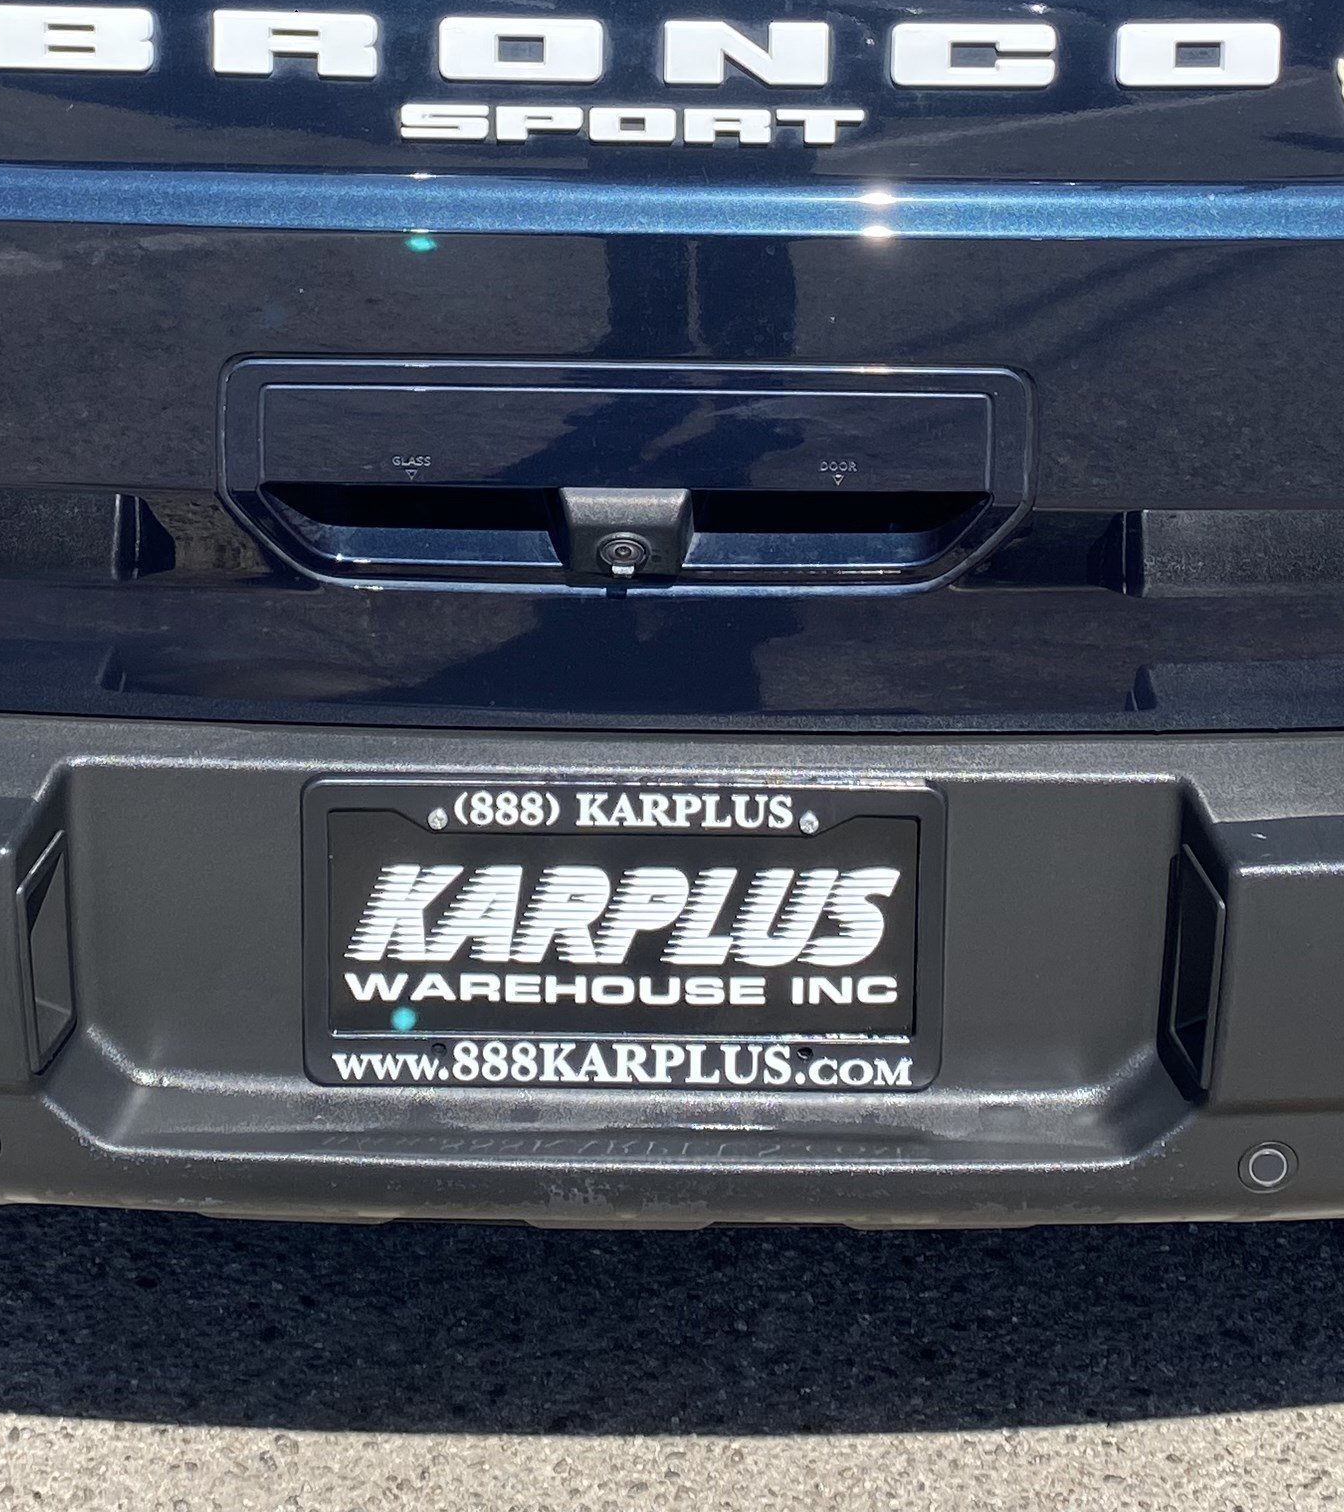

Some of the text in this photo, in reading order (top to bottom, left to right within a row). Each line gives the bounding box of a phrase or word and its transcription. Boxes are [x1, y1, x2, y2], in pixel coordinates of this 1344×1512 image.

[400, 103, 865, 144] SPORT
[392, 456, 431, 466] GLASS
[820, 461, 857, 472] DOOR
[453, 790, 794, 829] (888) KARPLUS
[344, 863, 901, 967] KARPLUS
[344, 972, 898, 1006] WAREHOUSE INC
